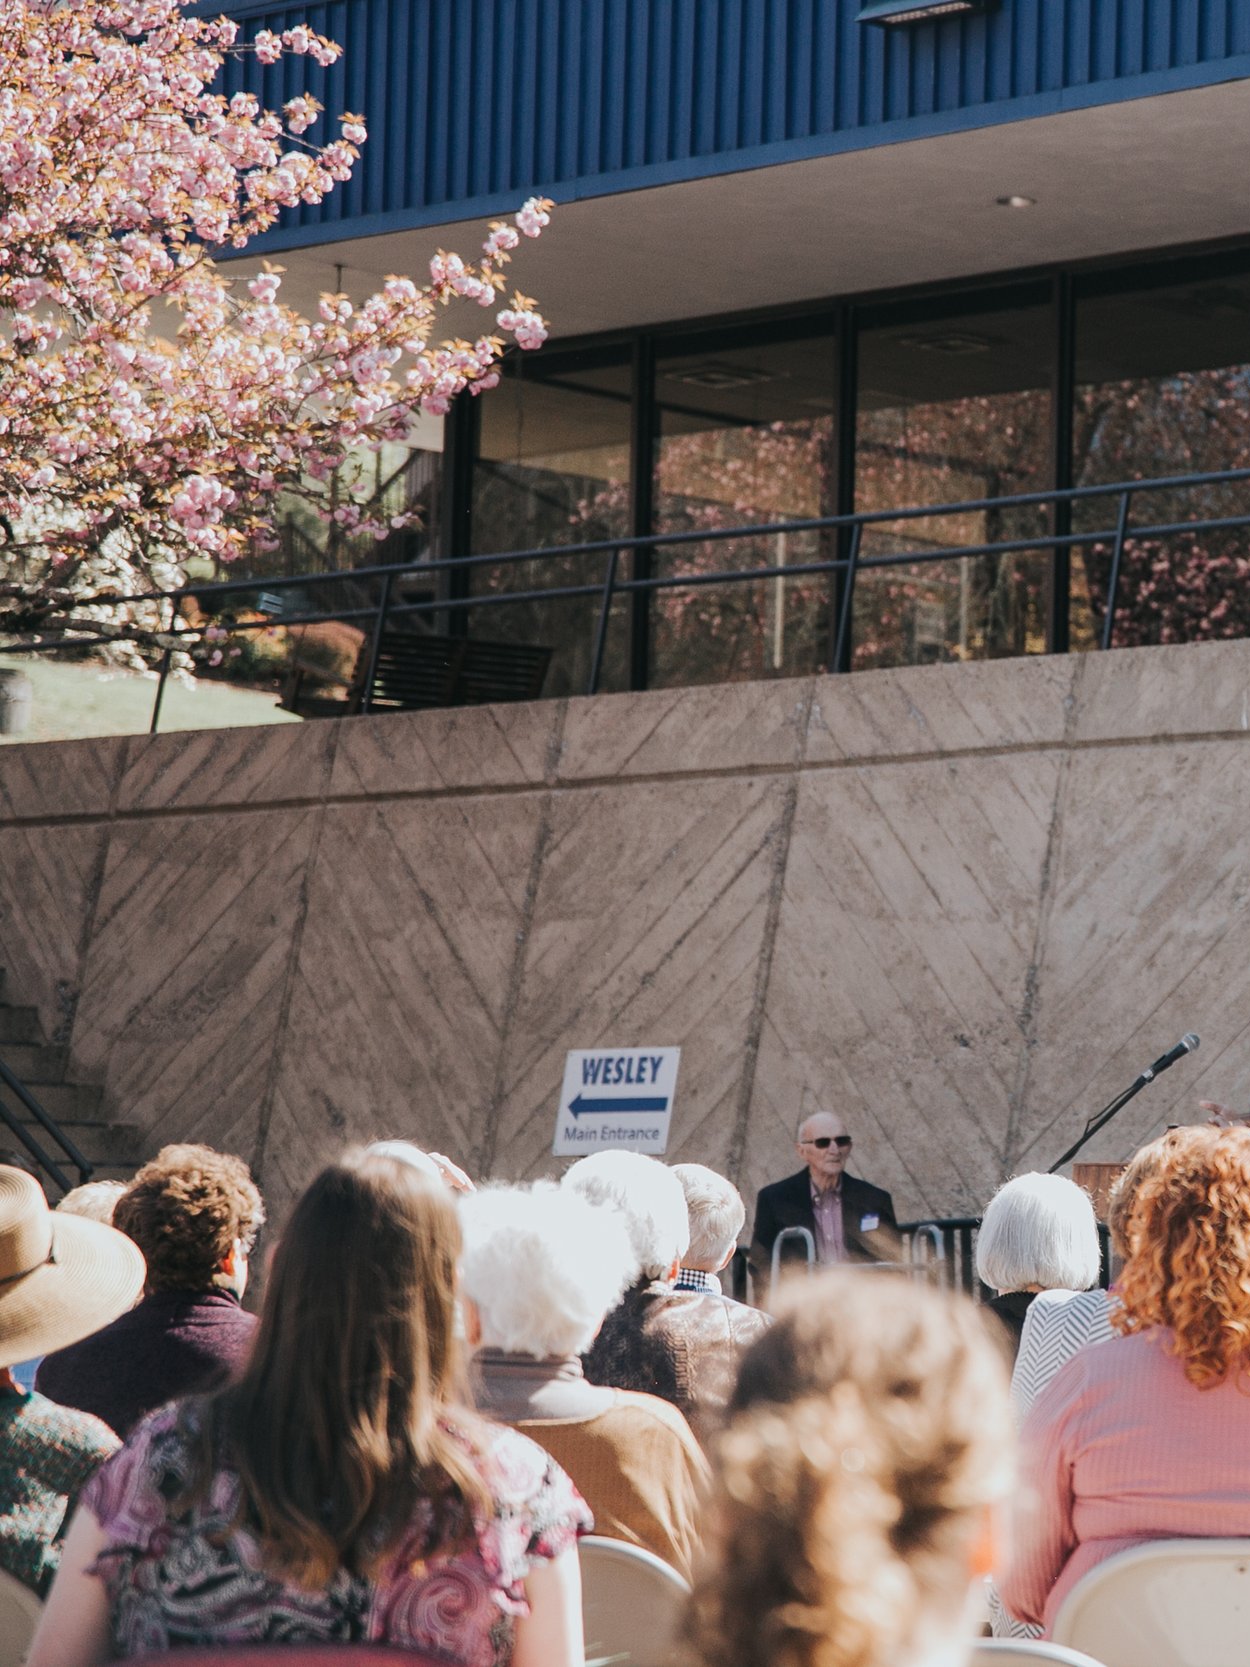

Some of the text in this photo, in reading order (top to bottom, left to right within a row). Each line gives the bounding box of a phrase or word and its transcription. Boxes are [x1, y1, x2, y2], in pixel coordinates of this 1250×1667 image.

[583, 1056, 663, 1085] WESLEY
[564, 1125, 660, 1142] Main Entrance
